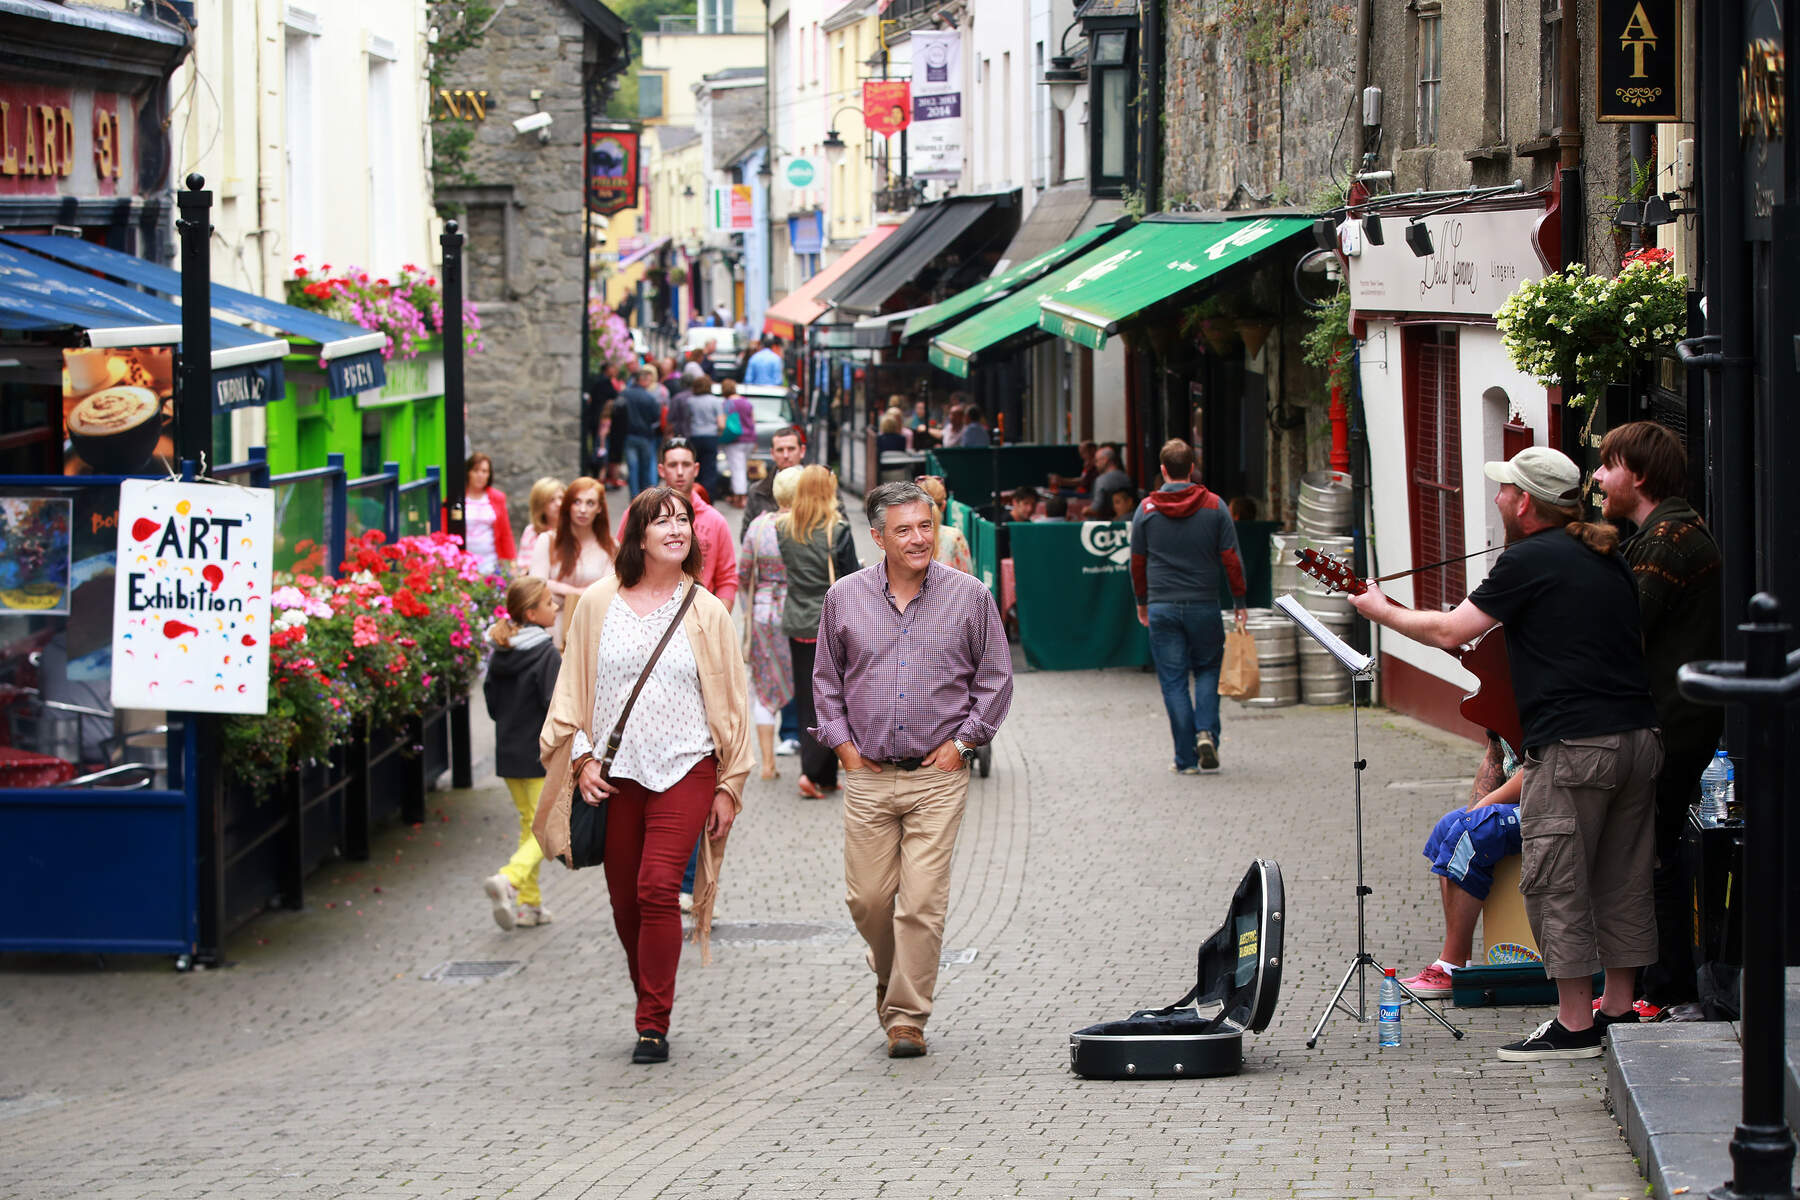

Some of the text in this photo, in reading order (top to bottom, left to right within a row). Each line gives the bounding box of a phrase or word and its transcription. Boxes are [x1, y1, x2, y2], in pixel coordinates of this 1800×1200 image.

[1490, 259, 1516, 282] Lingerie
[156, 516, 243, 560] ART
[129, 572, 242, 612] Exhibition
